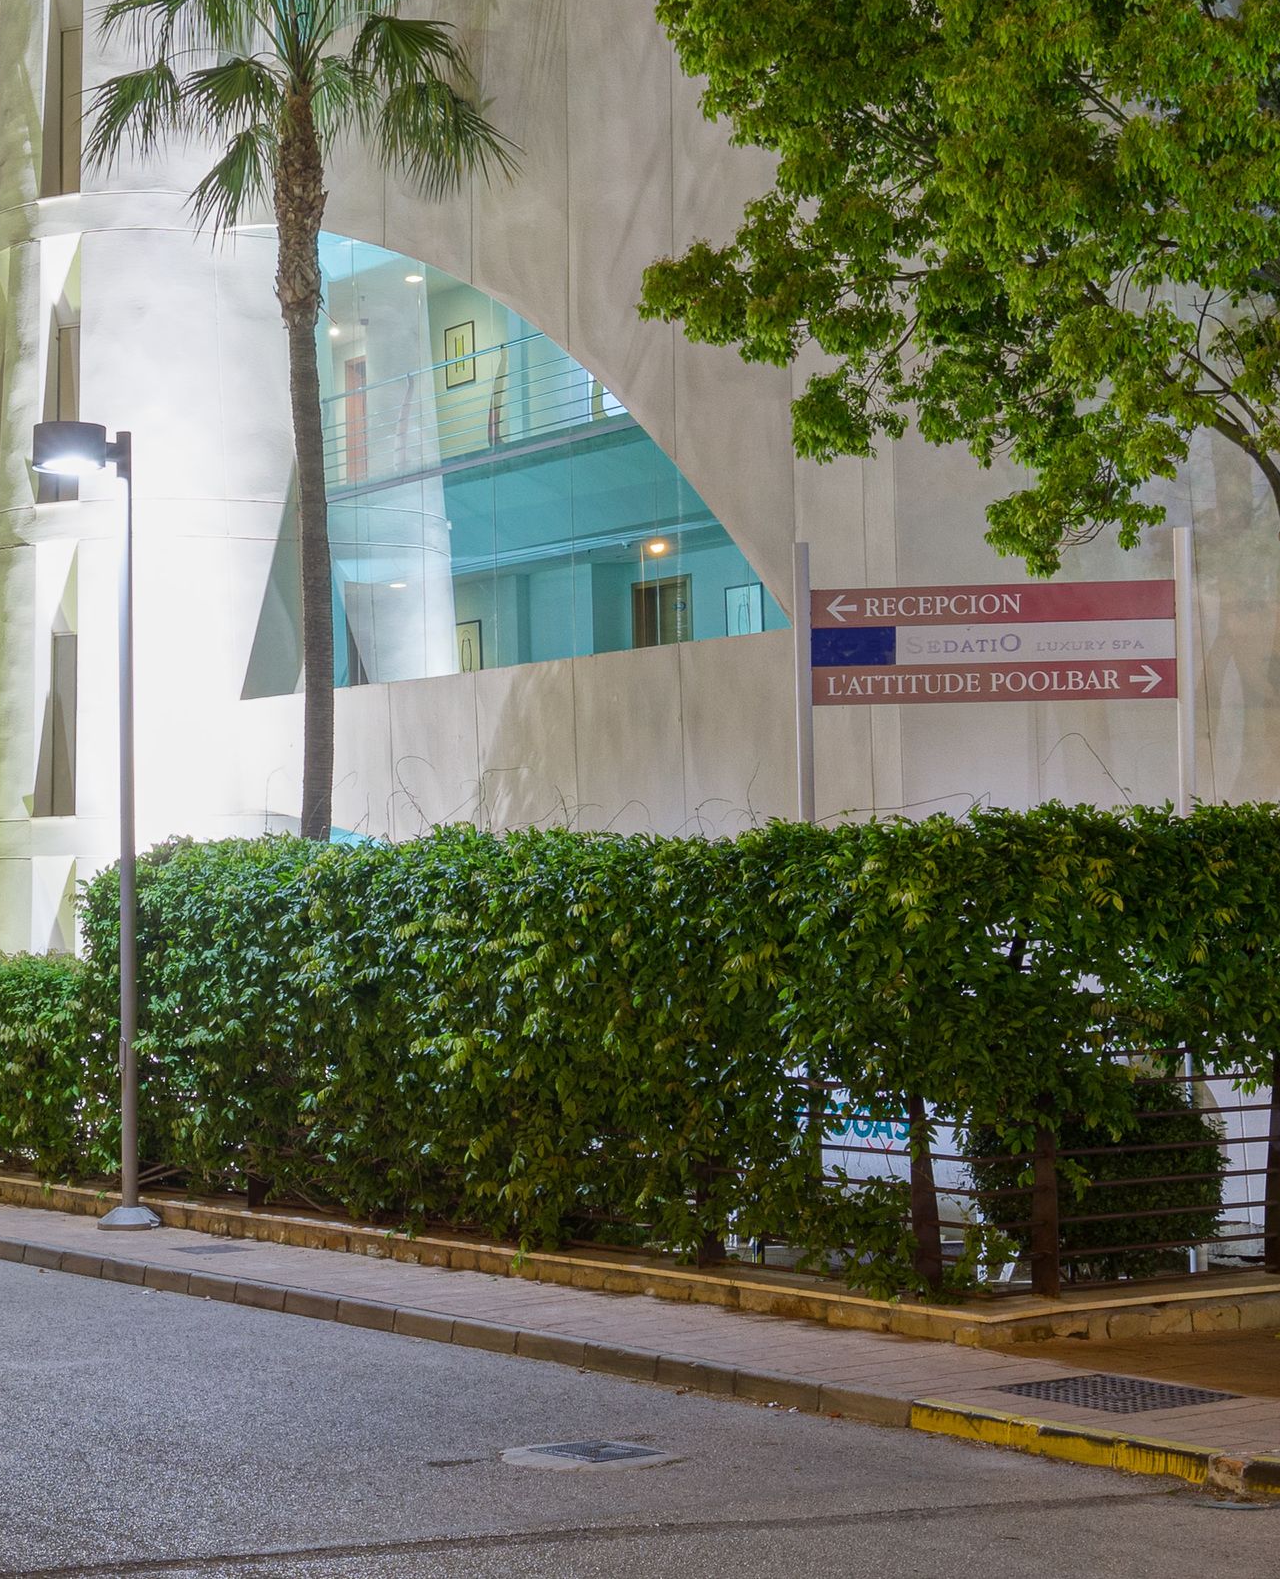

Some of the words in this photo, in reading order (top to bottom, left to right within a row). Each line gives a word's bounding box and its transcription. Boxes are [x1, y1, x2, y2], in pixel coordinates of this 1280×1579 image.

[863, 593, 1022, 618] RECEPCION
[905, 633, 1022, 655] SEDATIO
[1036, 640, 1106, 652] LUXURY
[1111, 639, 1145, 650] SPA
[827, 672, 982, 697] L'ATTITUDE
[989, 669, 1121, 693] POOLBAR
